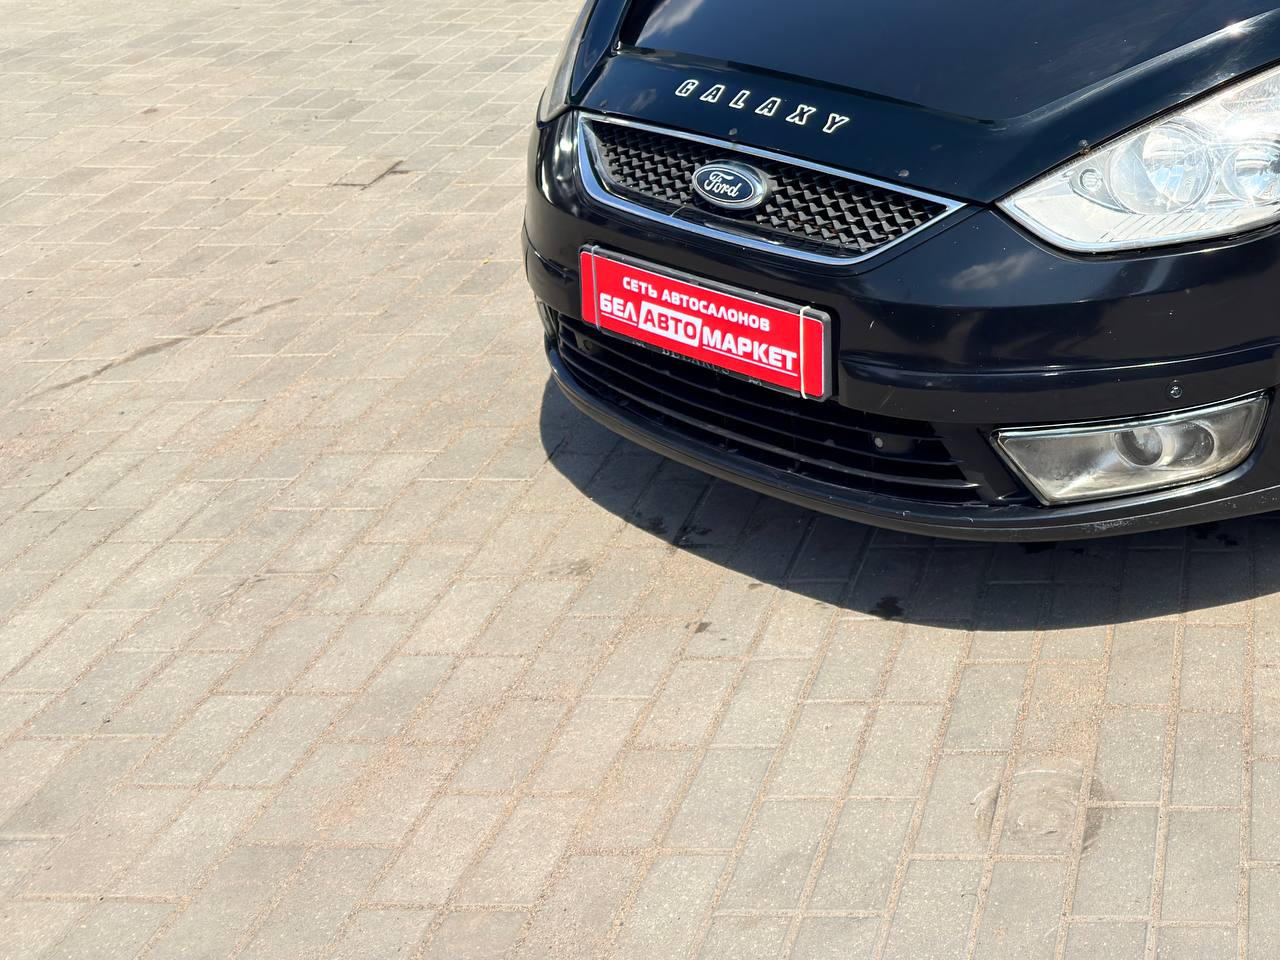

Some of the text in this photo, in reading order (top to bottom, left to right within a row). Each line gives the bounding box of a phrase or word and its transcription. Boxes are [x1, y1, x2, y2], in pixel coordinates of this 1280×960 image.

[675, 79, 849, 133] GALAXY
[704, 171, 742, 198] Ford
[600, 292, 798, 371] БЕЛ АВТО МАРКЕТ
[623, 276, 770, 332] СЕТЬ АВТОСАЛОНОВ
